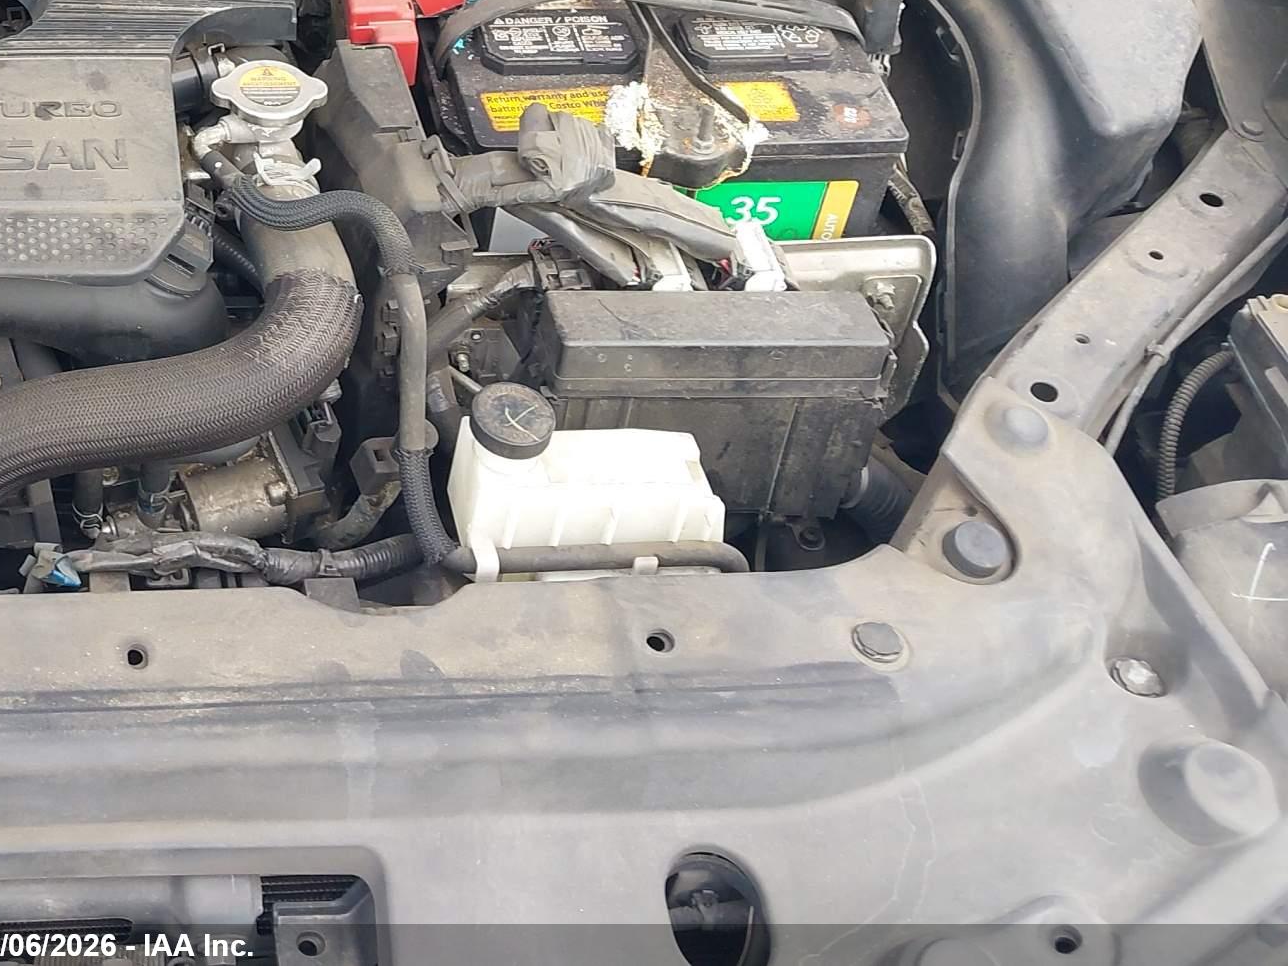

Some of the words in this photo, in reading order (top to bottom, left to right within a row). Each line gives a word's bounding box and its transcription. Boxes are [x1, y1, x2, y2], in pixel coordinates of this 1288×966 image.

[504, 16, 553, 25] DANGER
[564, 15, 609, 24] POISON
[486, 96, 521, 104] Return
[523, 93, 568, 103] warranty
[570, 90, 590, 99] and
[725, 195, 782, 226] 35
